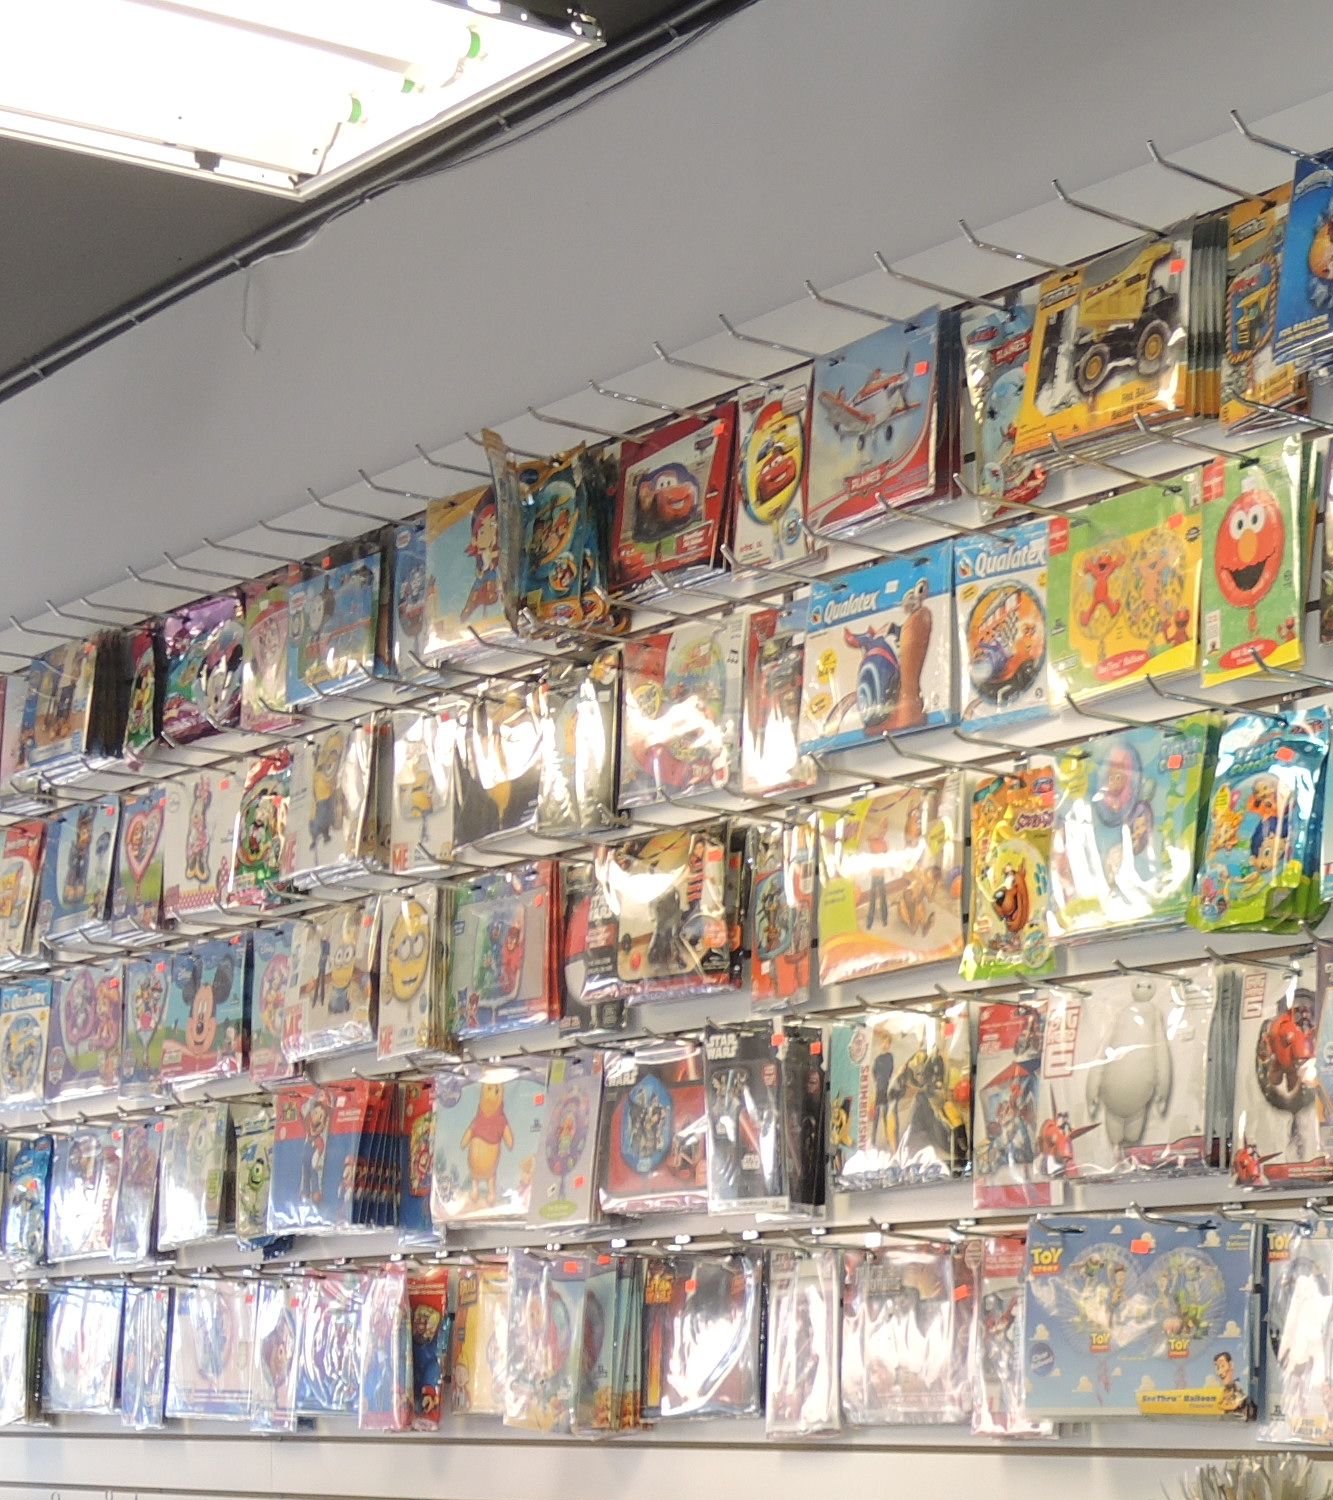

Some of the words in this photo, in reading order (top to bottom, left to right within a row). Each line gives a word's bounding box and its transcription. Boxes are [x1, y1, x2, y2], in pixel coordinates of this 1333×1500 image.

[852, 470, 882, 490] PLANES
[975, 543, 1047, 578] Qualatex
[824, 592, 878, 624] Qualatex
[705, 1032, 738, 1048] STAR
[705, 1046, 737, 1061] WARS
[606, 1069, 638, 1088] WARS
[1267, 1232, 1291, 1250] TOY
[1031, 1248, 1063, 1265] TOY
[1090, 1332, 1111, 1345] TOY
[1167, 1338, 1189, 1351] TOY
[1183, 1392, 1216, 1404] Balloon
